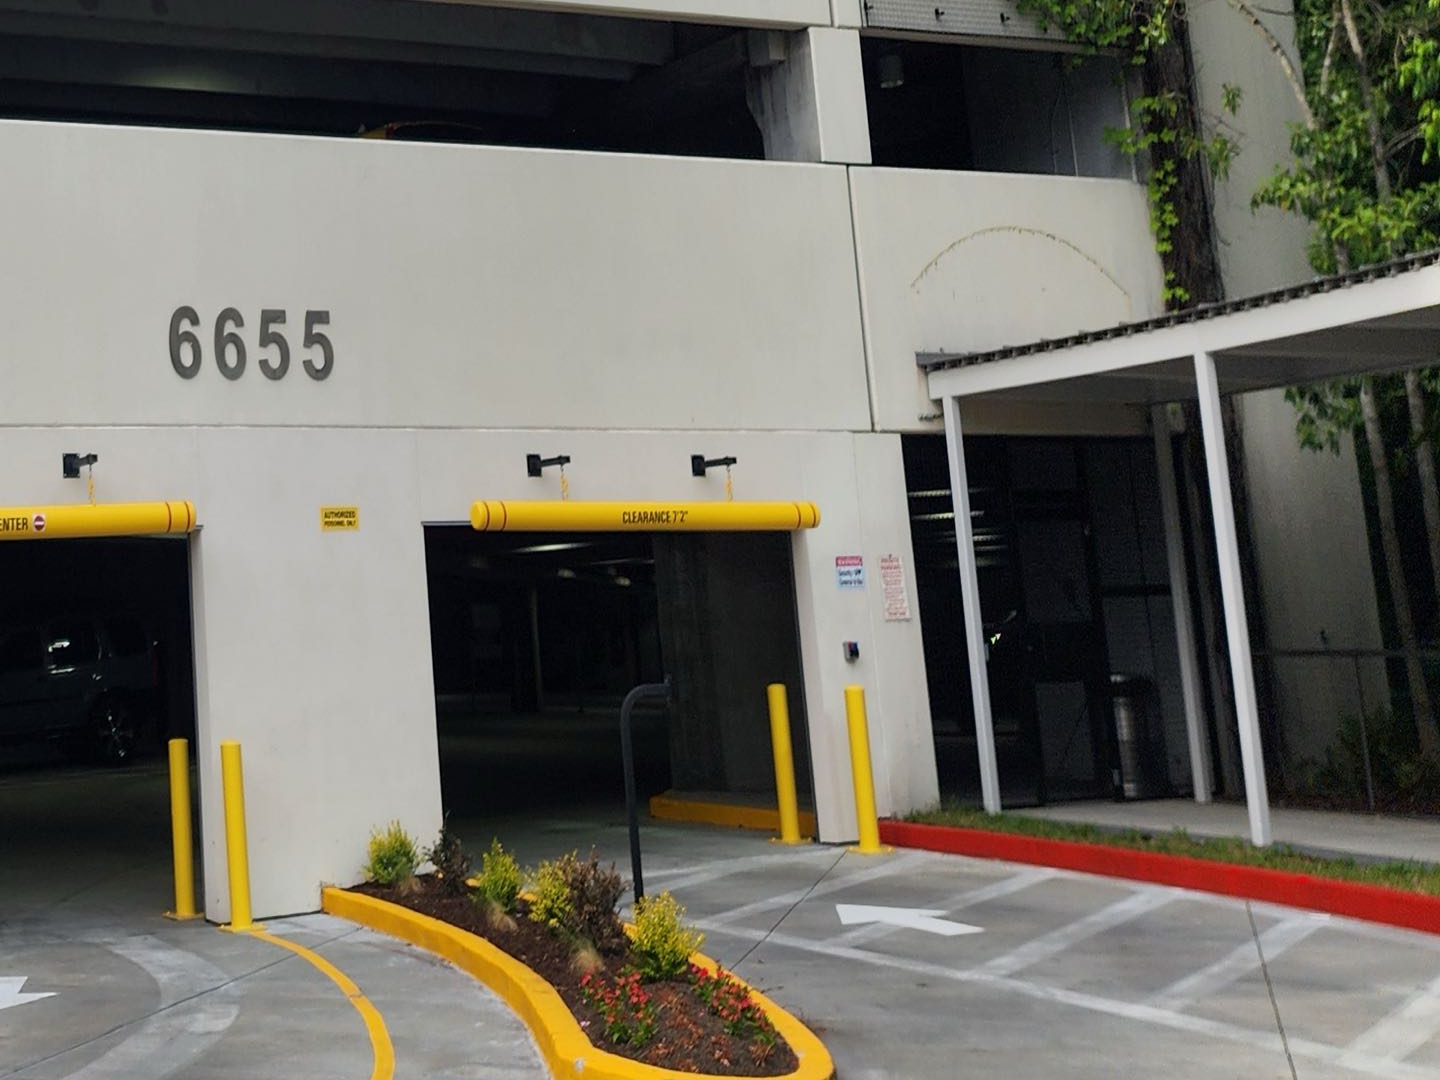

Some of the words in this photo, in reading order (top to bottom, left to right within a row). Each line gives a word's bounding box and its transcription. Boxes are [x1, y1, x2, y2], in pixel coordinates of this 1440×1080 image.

[169, 305, 334, 381] 6655
[324, 511, 356, 519] AUTHORIZED
[622, 510, 671, 524] CLEARANCE
